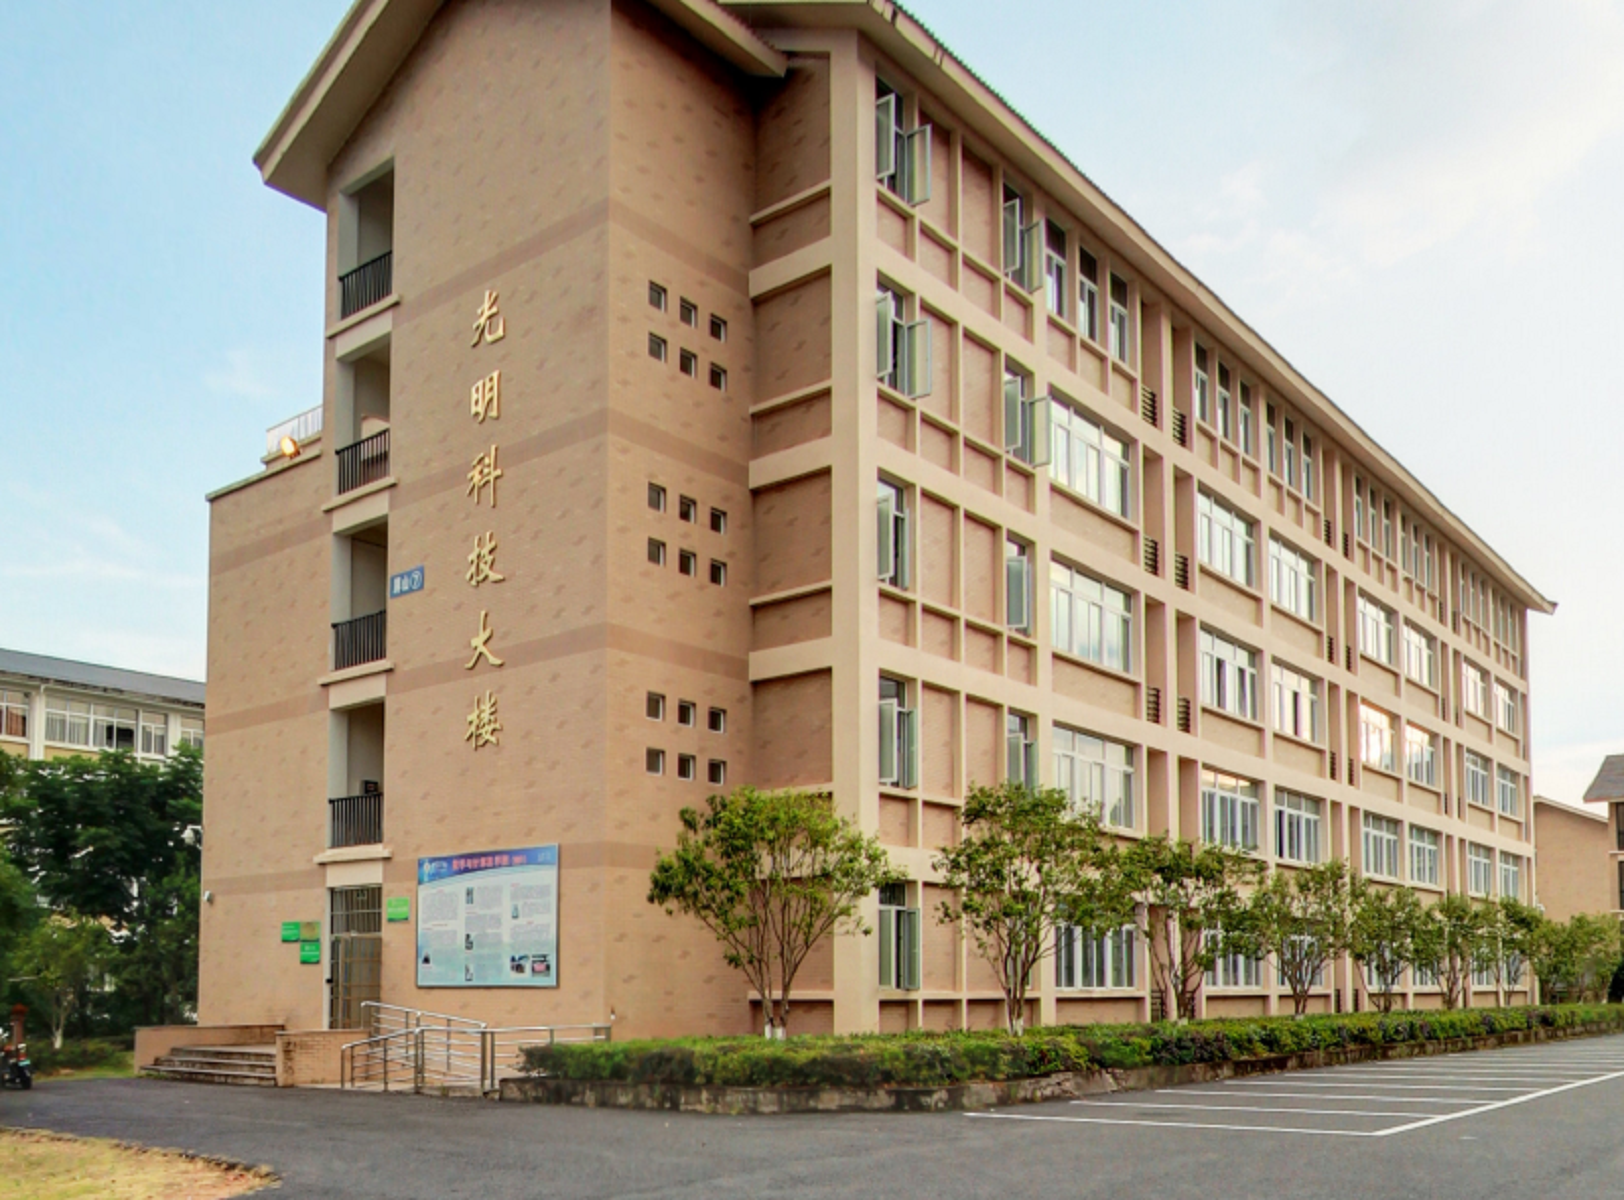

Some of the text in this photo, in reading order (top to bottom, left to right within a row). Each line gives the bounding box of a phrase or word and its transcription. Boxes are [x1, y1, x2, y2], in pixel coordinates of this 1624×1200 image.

[464, 289, 506, 751] 光明科技大楼
